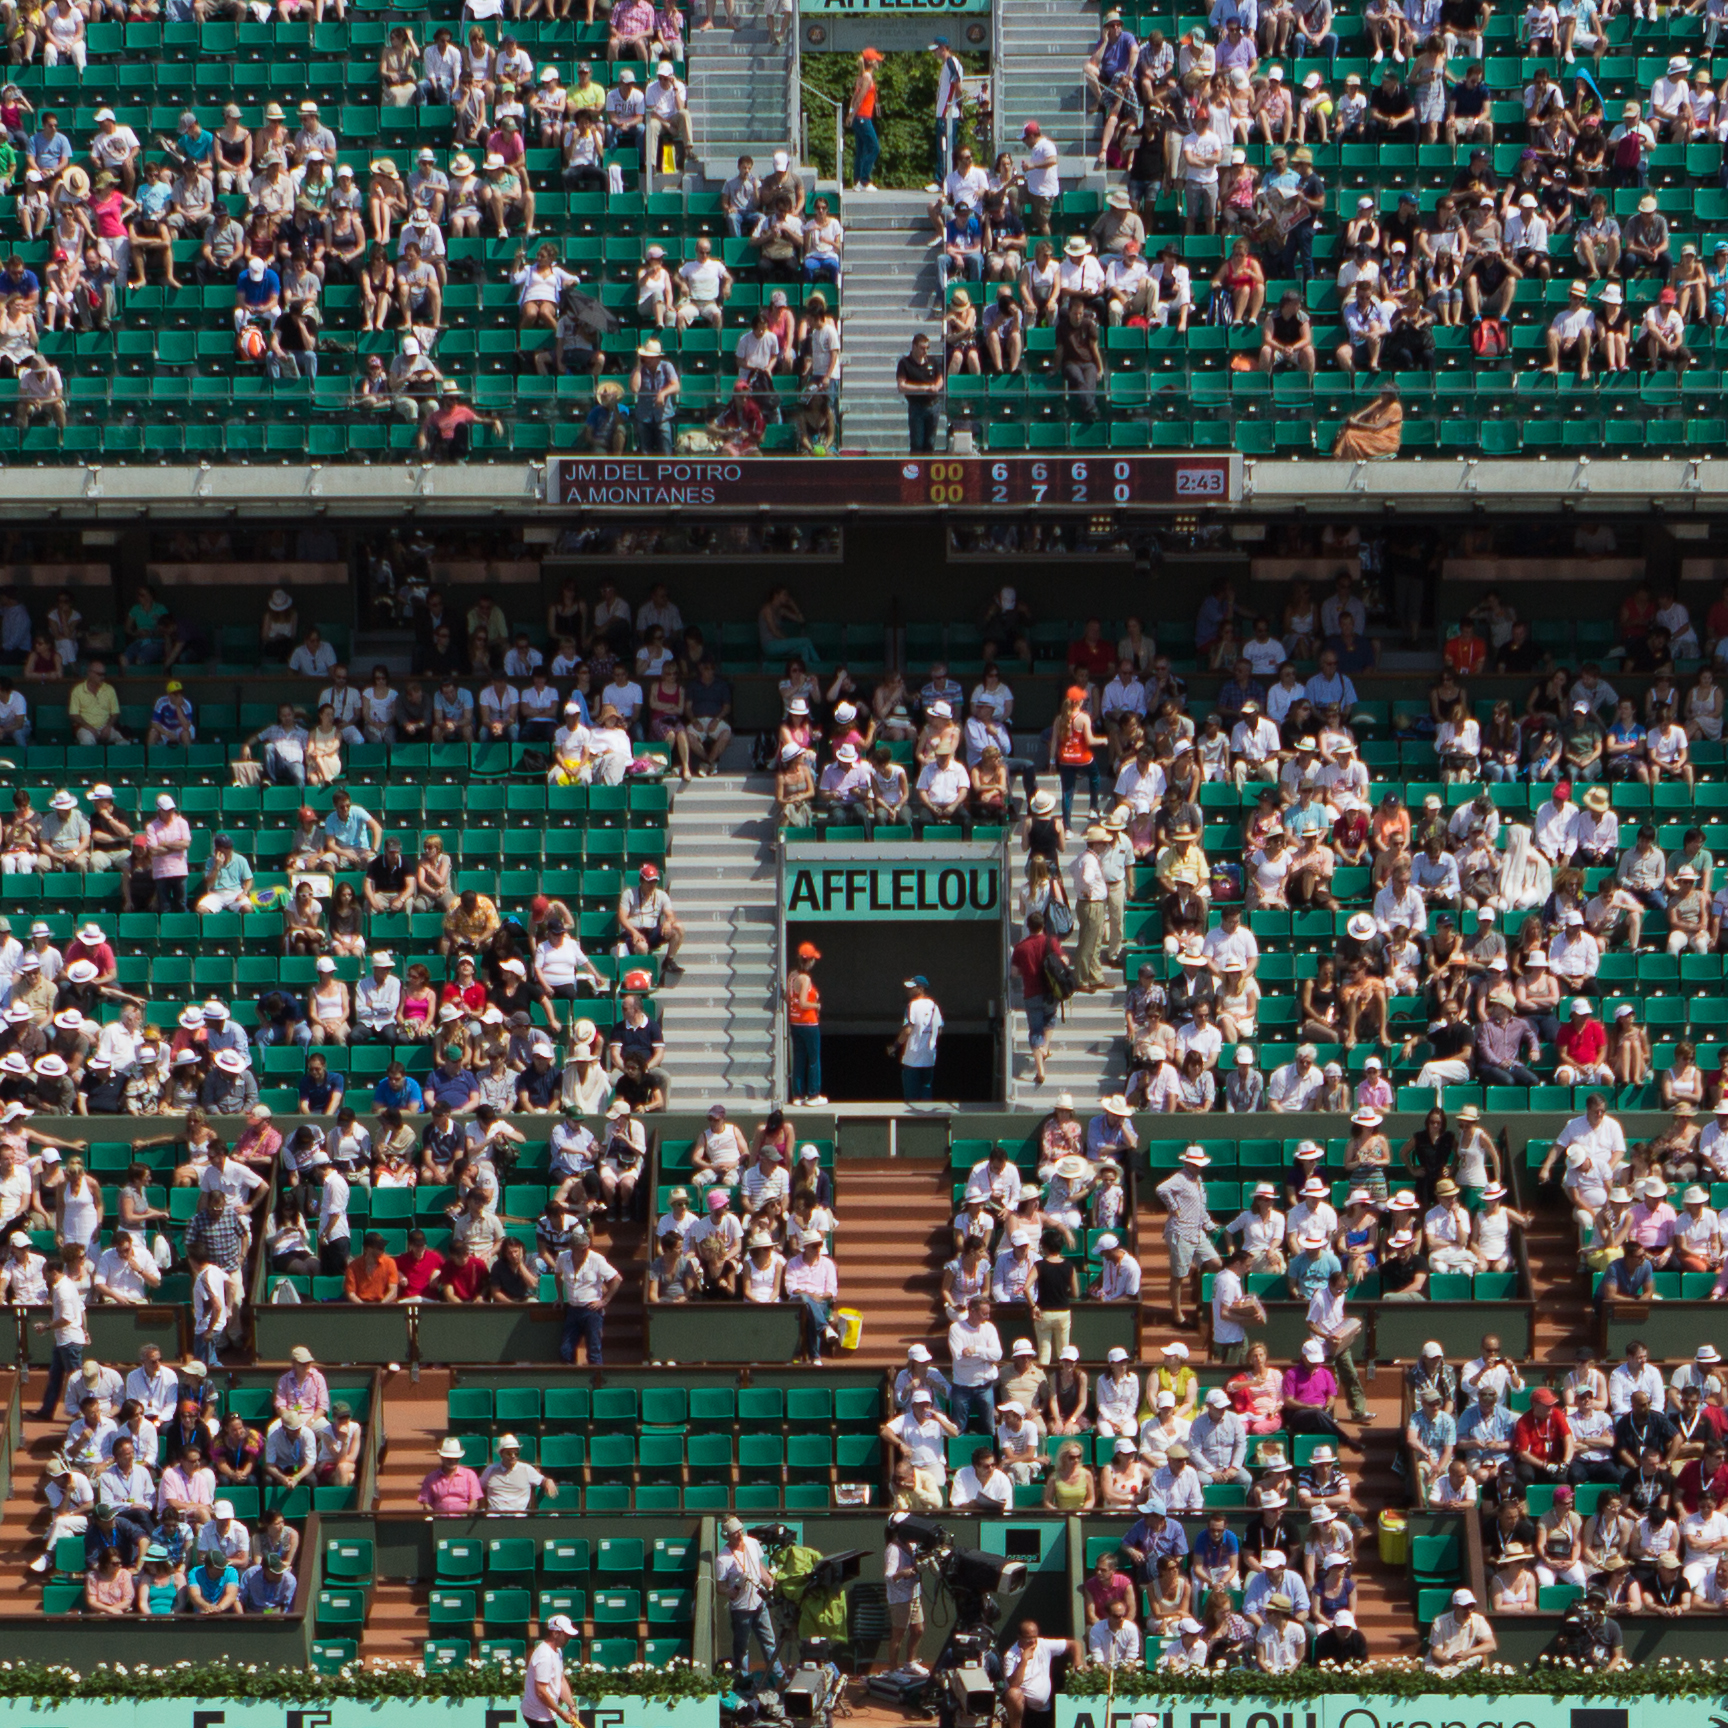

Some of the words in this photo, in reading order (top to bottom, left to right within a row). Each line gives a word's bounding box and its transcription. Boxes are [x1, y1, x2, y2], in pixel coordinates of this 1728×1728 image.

[565, 464, 650, 481] JM.DEL
[658, 464, 741, 481] POTRO
[931, 463, 963, 480] 00
[992, 463, 1008, 480] 6
[1032, 463, 1047, 480] 6
[1072, 463, 1087, 480] 6
[1114, 463, 1129, 480] 0
[1179, 475, 1221, 491] 2:43
[567, 486, 715, 503] A.MONTANES
[931, 485, 963, 502] 00
[992, 485, 1008, 502] 2
[1032, 485, 1047, 502] 7
[1072, 485, 1087, 502] 2
[1114, 485, 1129, 502] 0
[788, 869, 996, 911] AFFLELOU
